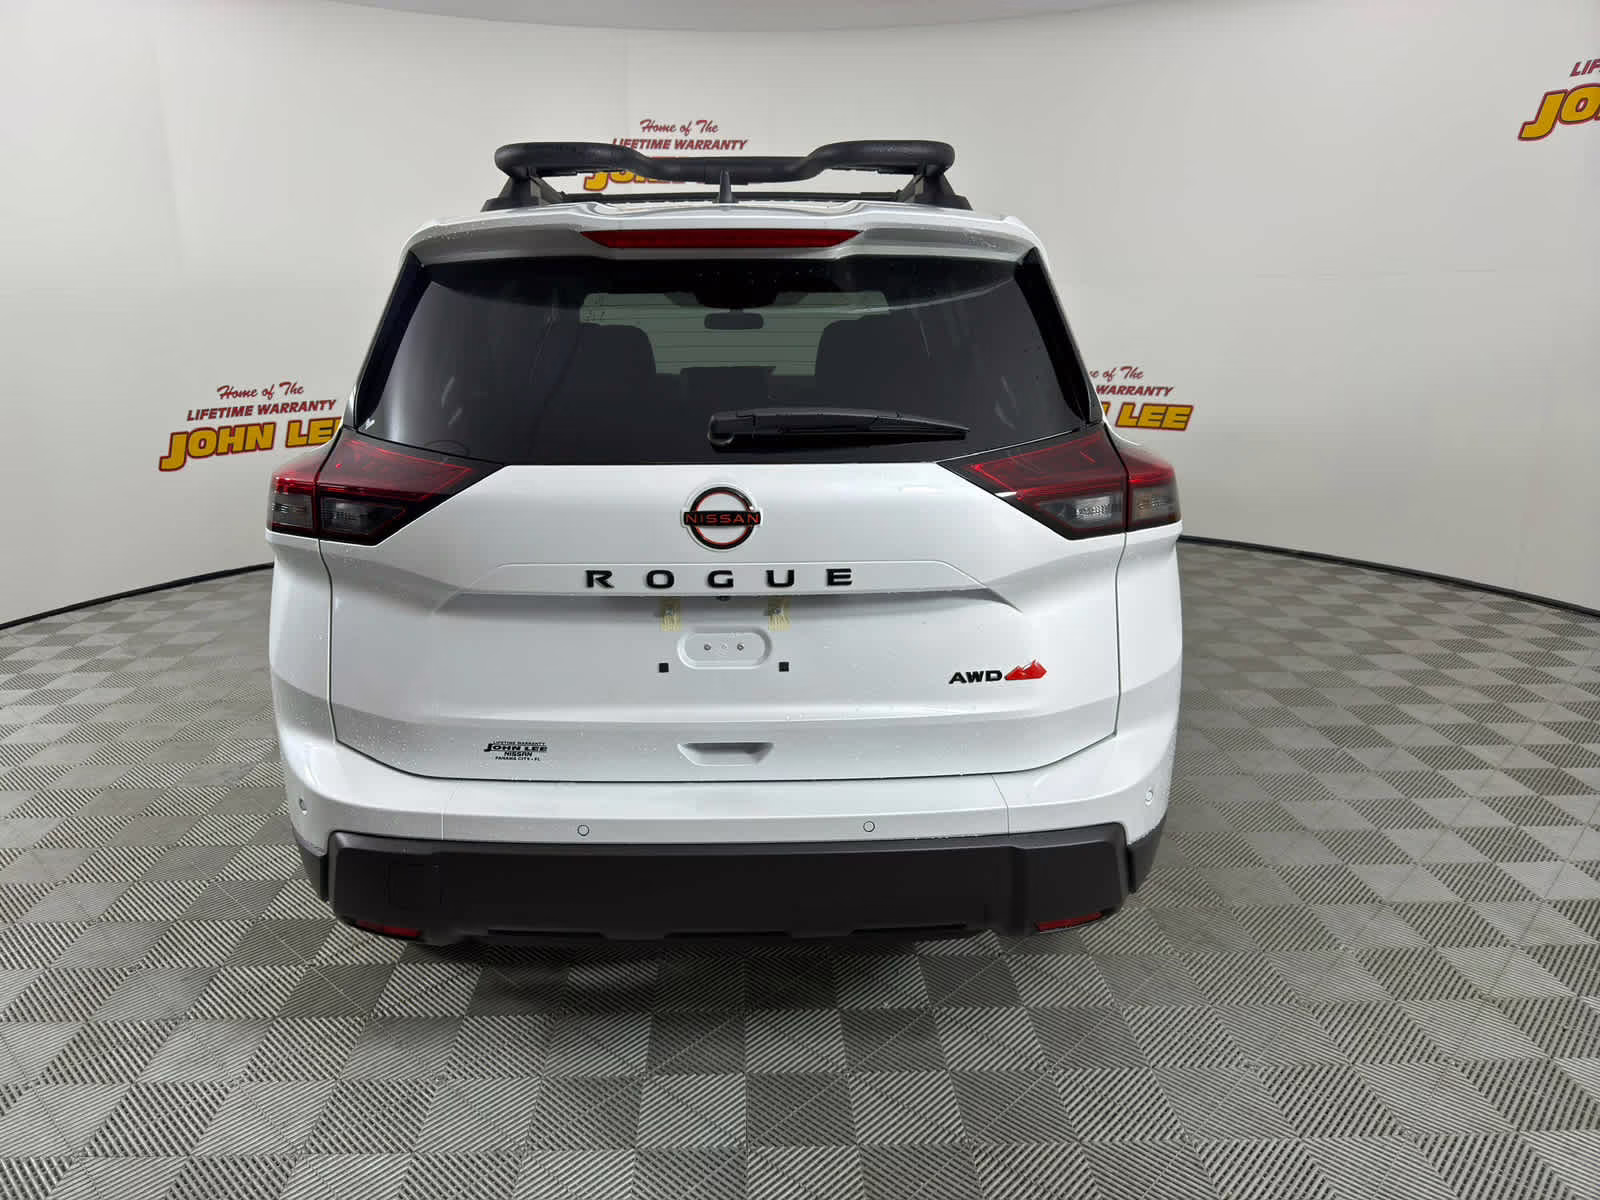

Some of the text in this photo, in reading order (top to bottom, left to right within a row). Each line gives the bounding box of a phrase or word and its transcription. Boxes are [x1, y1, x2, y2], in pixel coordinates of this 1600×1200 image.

[1569, 58, 1600, 77] LIF
[1518, 82, 1600, 141] JO
[640, 118, 719, 137] Home of The
[674, 139, 748, 151] WARRANTY
[1102, 367, 1117, 382] of
[1120, 366, 1144, 379] The
[217, 381, 304, 400] Home of The
[1096, 385, 1174, 396] WARRANTY
[187, 399, 337, 422] LIFETIME WARRANTY
[1115, 402, 1194, 431] LEE
[159, 422, 276, 471] JOHN
[685, 513, 760, 525] NISSAN
[584, 568, 853, 589] ROGUE
[948, 670, 1003, 684] AWD
[484, 743, 521, 752] JOHN
